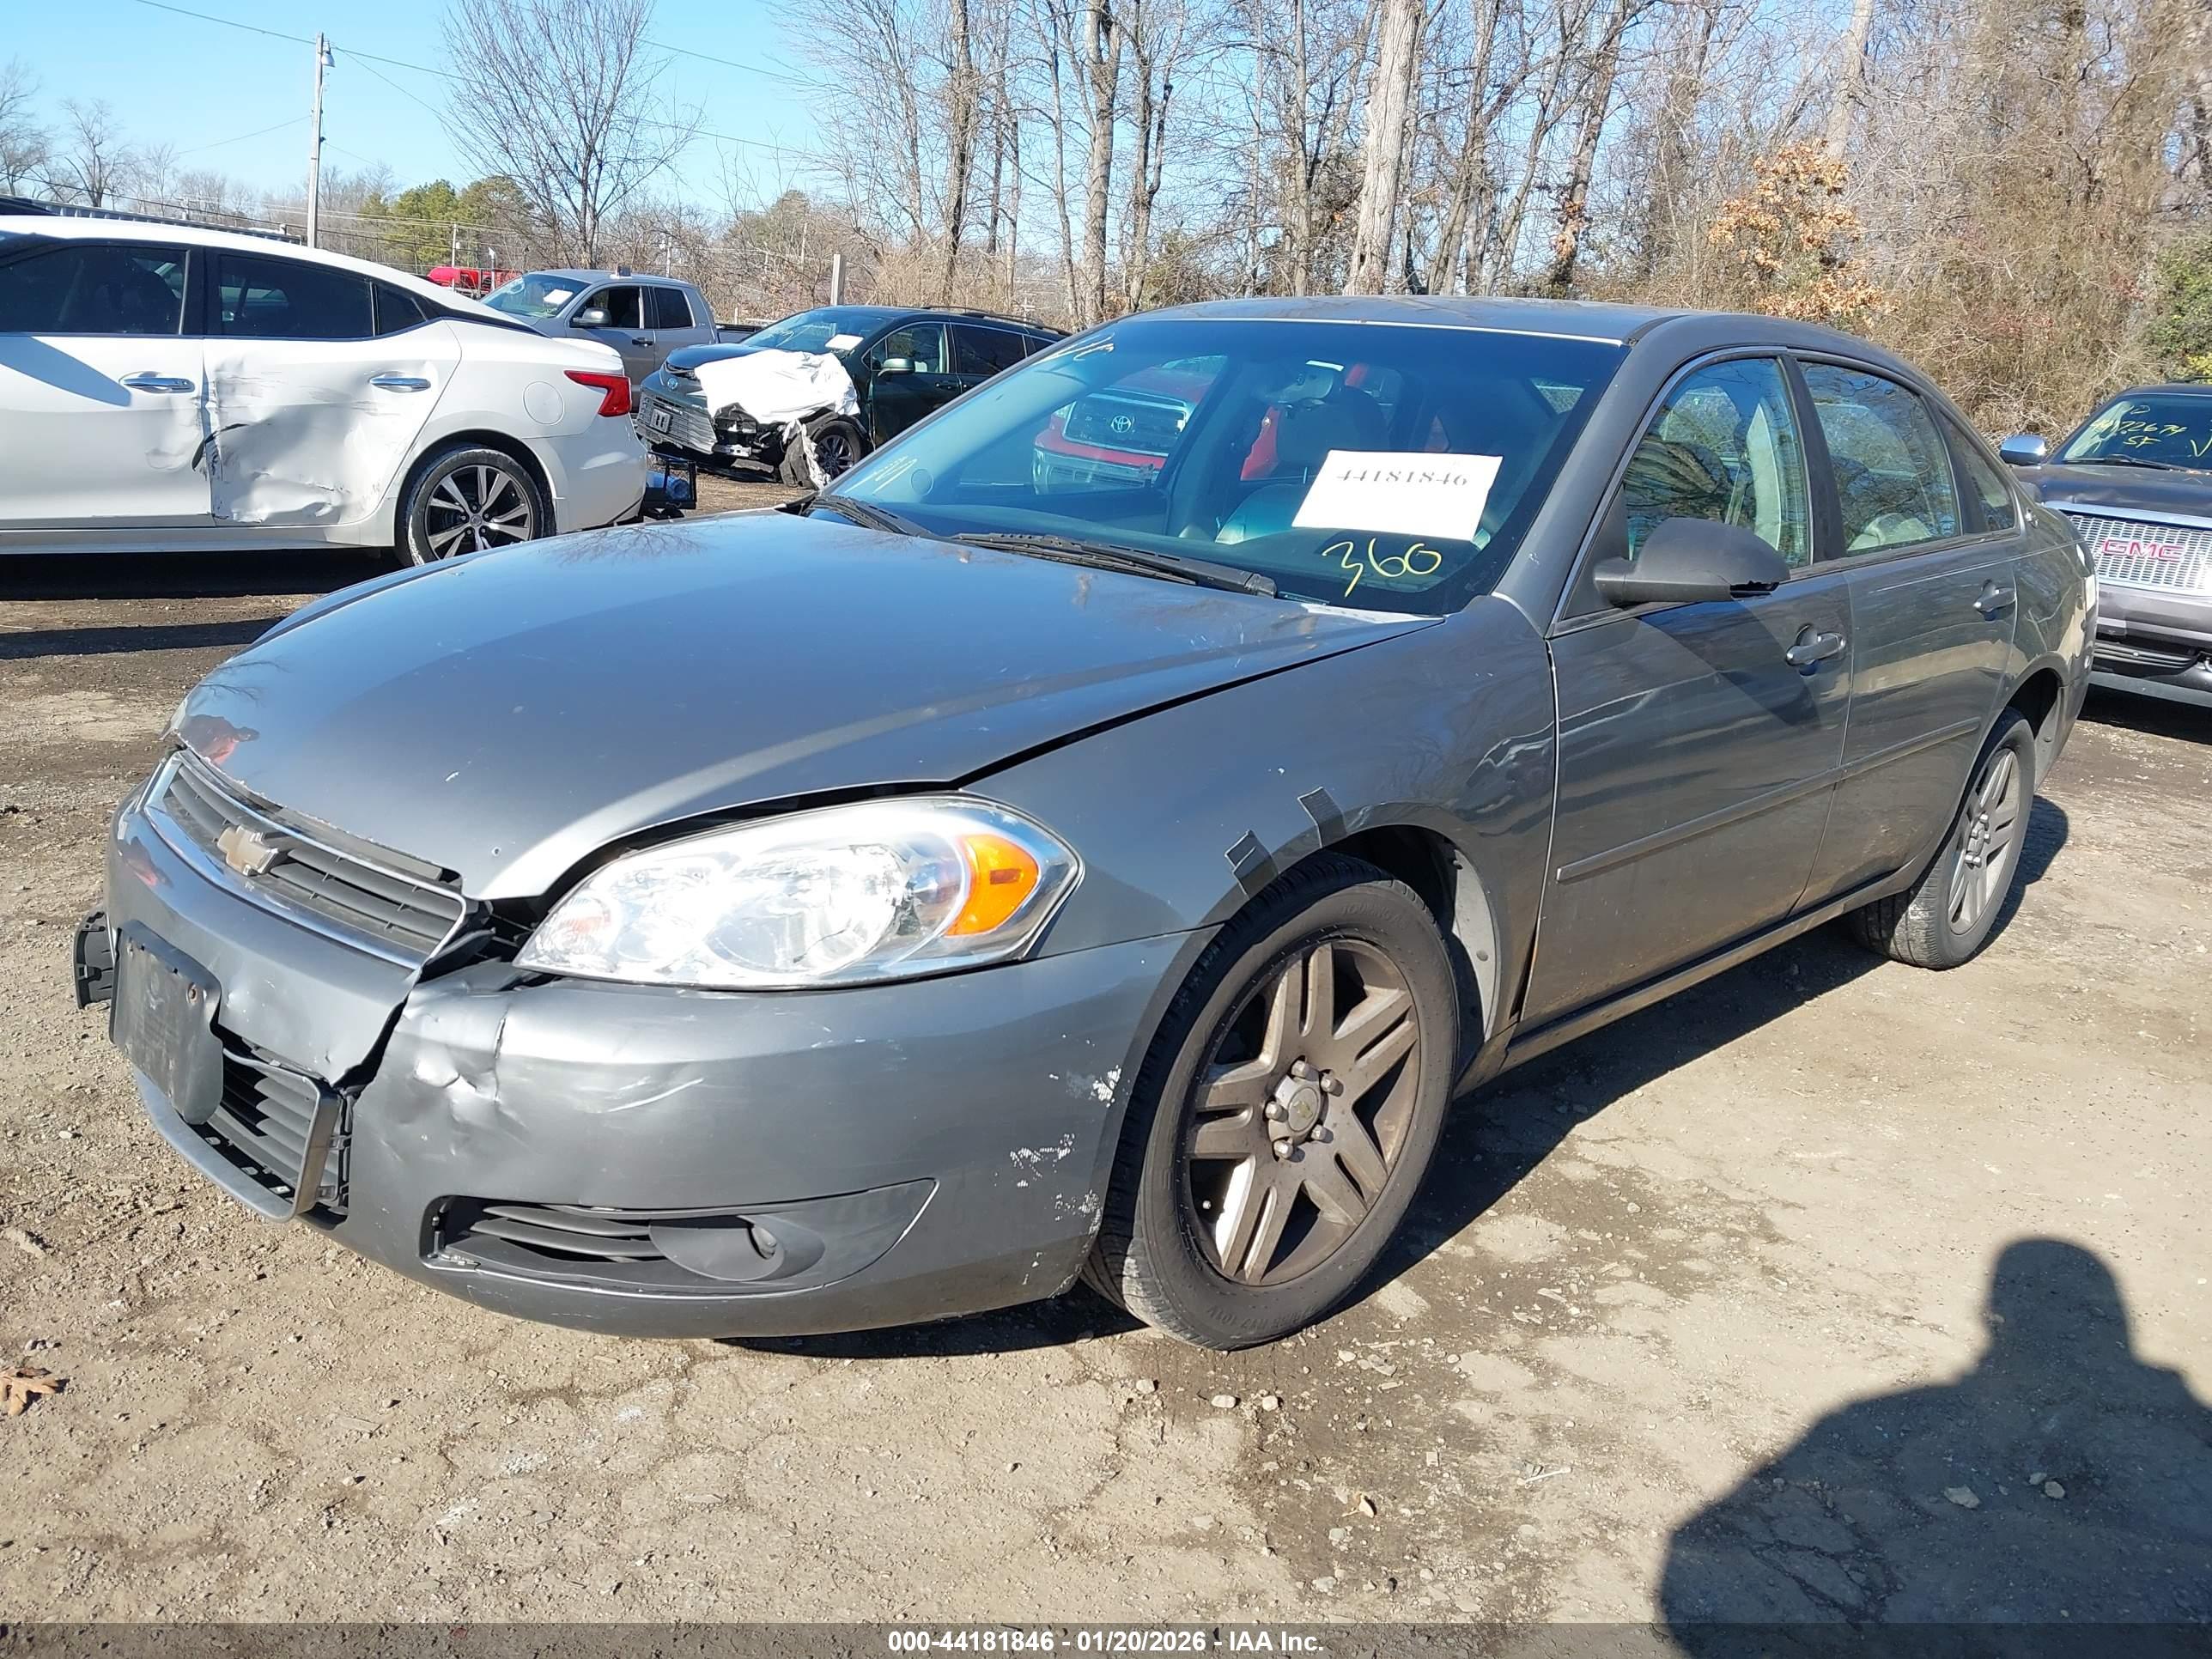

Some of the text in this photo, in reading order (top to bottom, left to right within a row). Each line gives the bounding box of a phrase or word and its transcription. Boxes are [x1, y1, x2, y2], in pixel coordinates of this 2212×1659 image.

[1336, 469, 1468, 487] 44181846
[2103, 539, 2185, 563] GMC
[1322, 538, 1443, 599] 360
